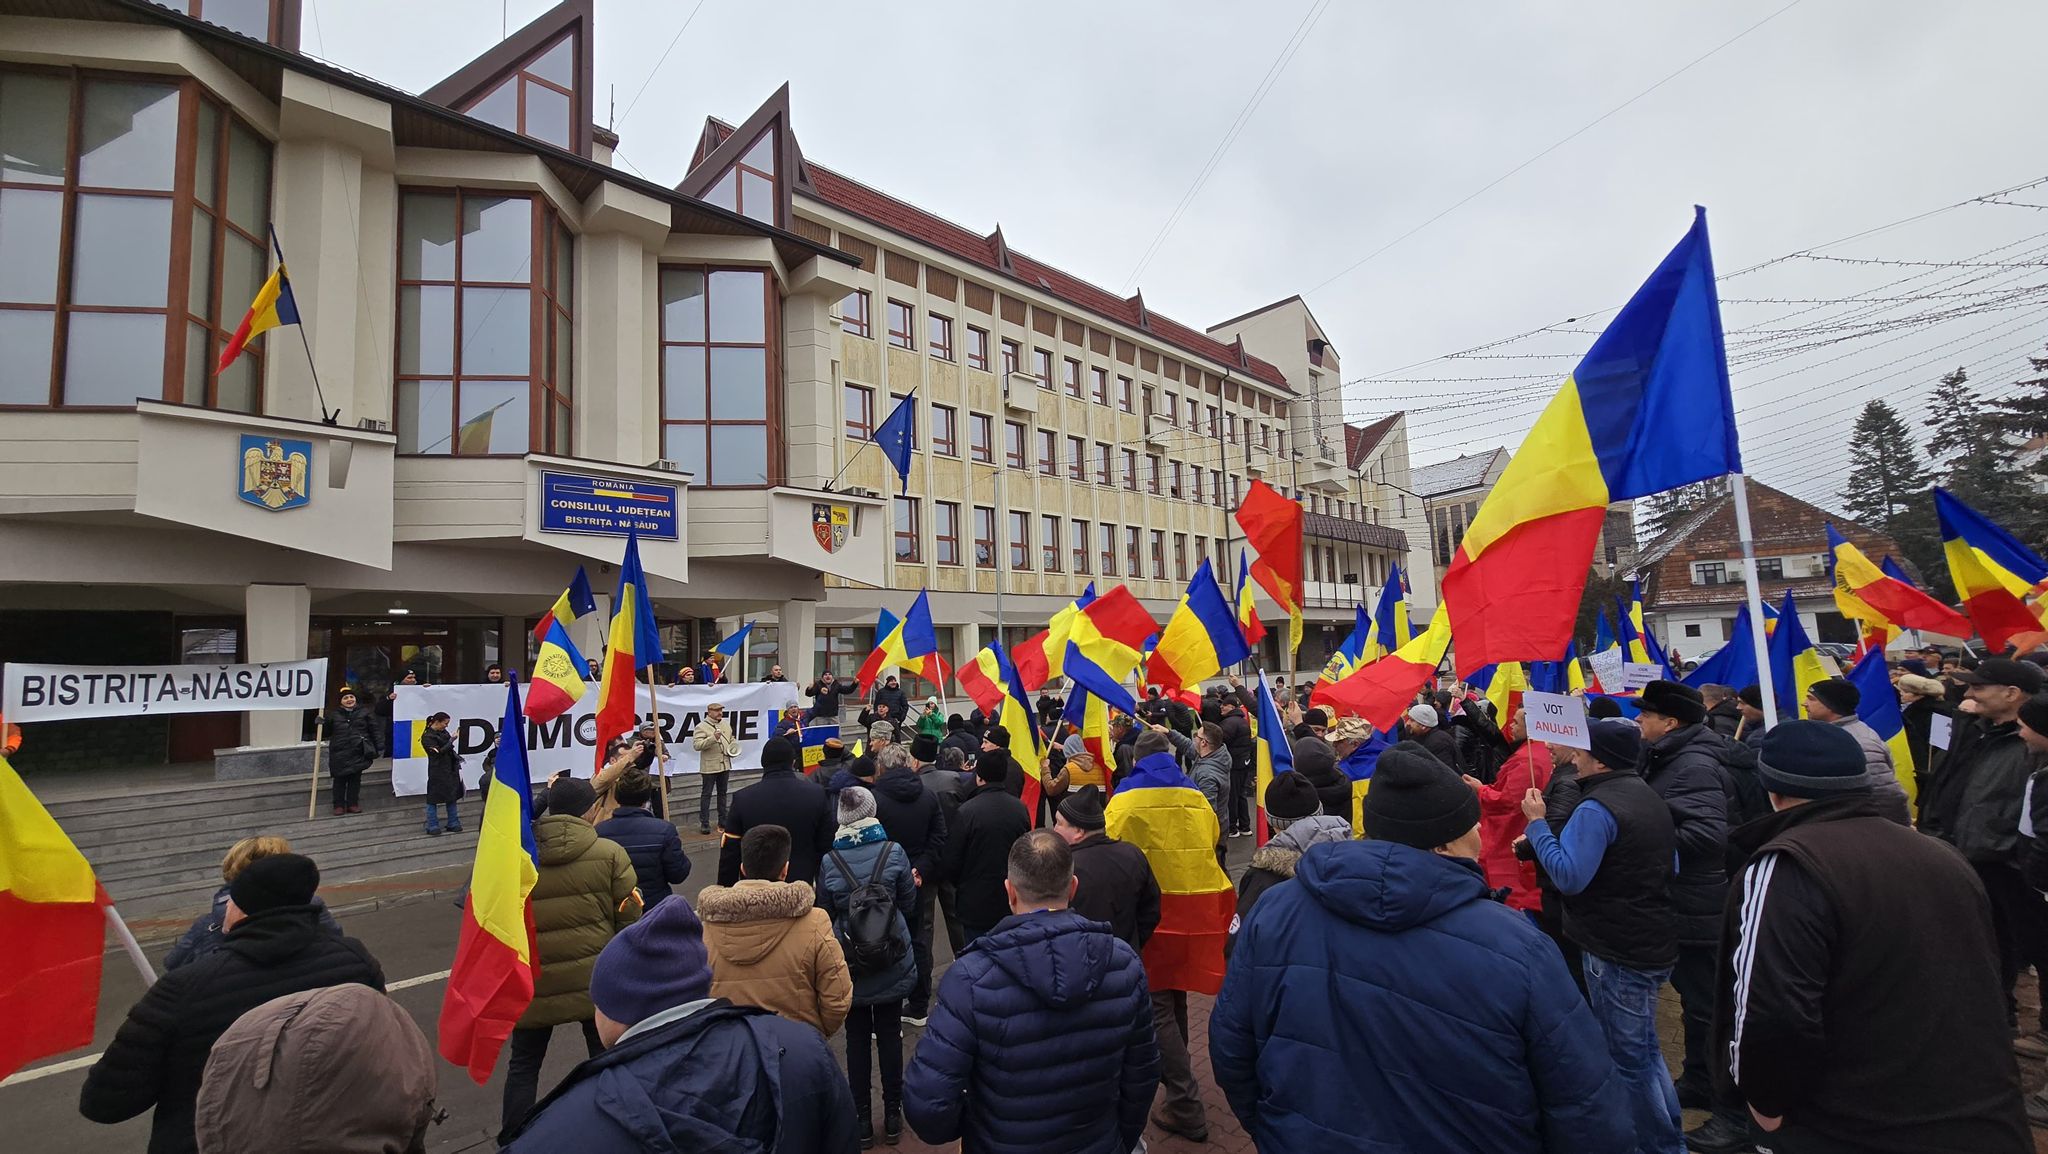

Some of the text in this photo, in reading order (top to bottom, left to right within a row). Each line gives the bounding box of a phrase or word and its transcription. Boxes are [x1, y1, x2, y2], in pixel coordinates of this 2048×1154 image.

[551, 499, 671, 519] CONSILIUL JUDEȚEAN
[1543, 703, 1564, 716] VOT
[1535, 721, 1578, 737] ANULAT!
